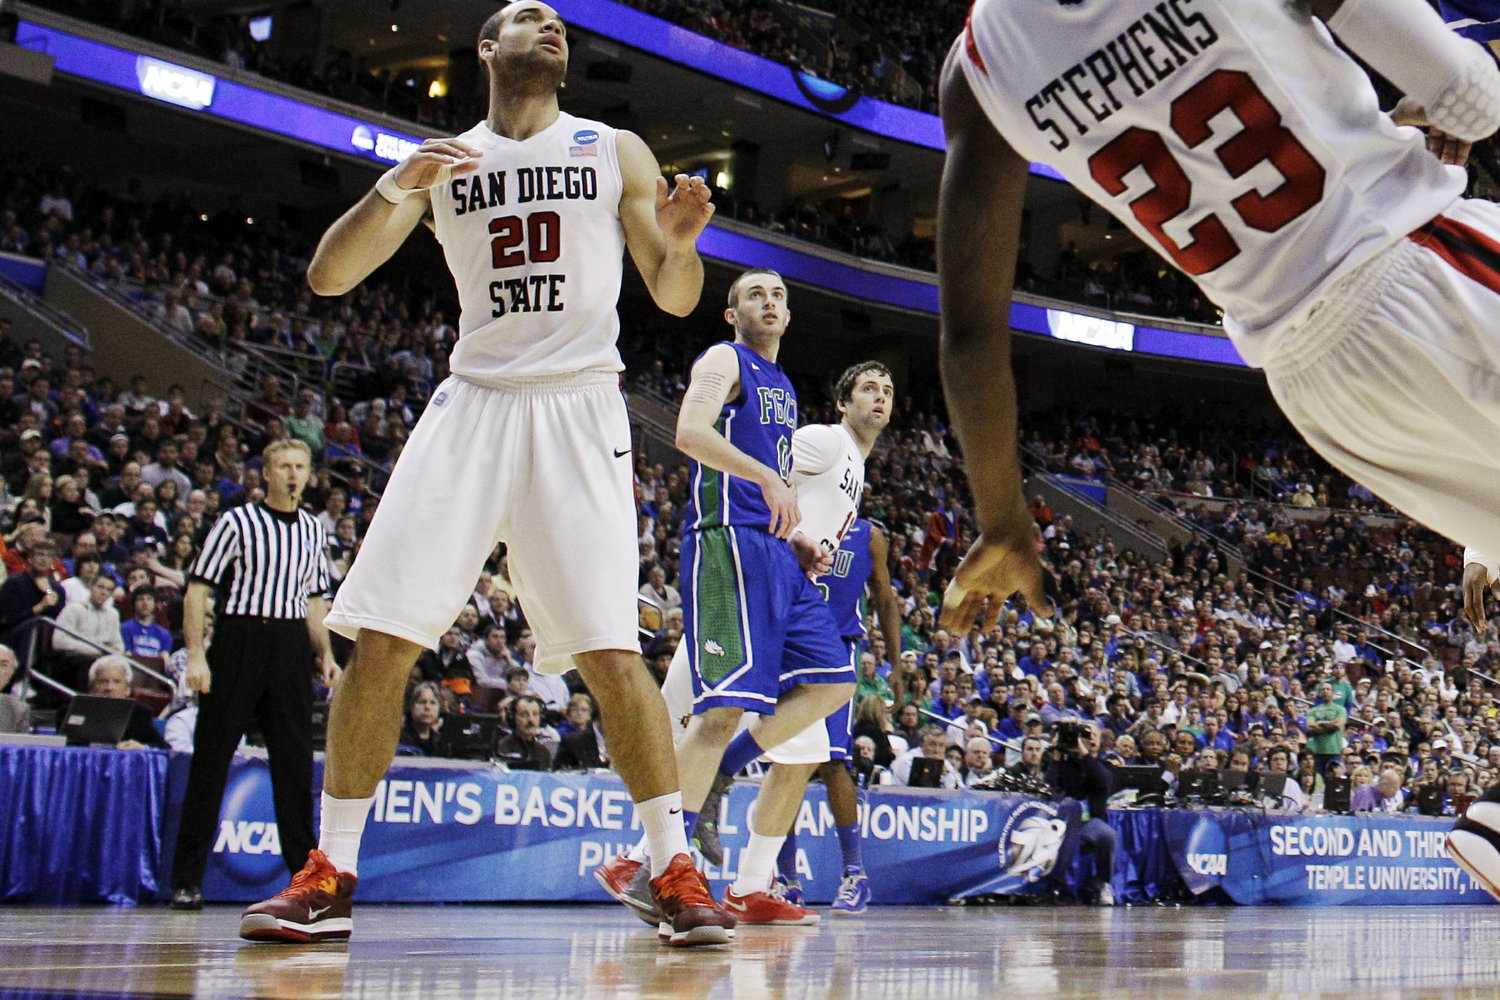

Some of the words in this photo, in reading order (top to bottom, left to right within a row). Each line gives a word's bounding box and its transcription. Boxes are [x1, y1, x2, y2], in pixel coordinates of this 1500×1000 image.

[451, 171, 507, 216] SAN
[517, 166, 598, 203] DIEGO
[1087, 68, 1327, 277] 23
[488, 210, 561, 270] 20
[489, 274, 566, 319] STATE
[757, 386, 798, 430] FGC
[213, 820, 282, 855] NCA
[1270, 825, 1353, 856] SECOND
[1358, 829, 1401, 857] AND
[1405, 831, 1452, 858] THIR
[1305, 865, 1365, 891] TEMPLE
[1368, 866, 1466, 895] UNIVERSITY,
